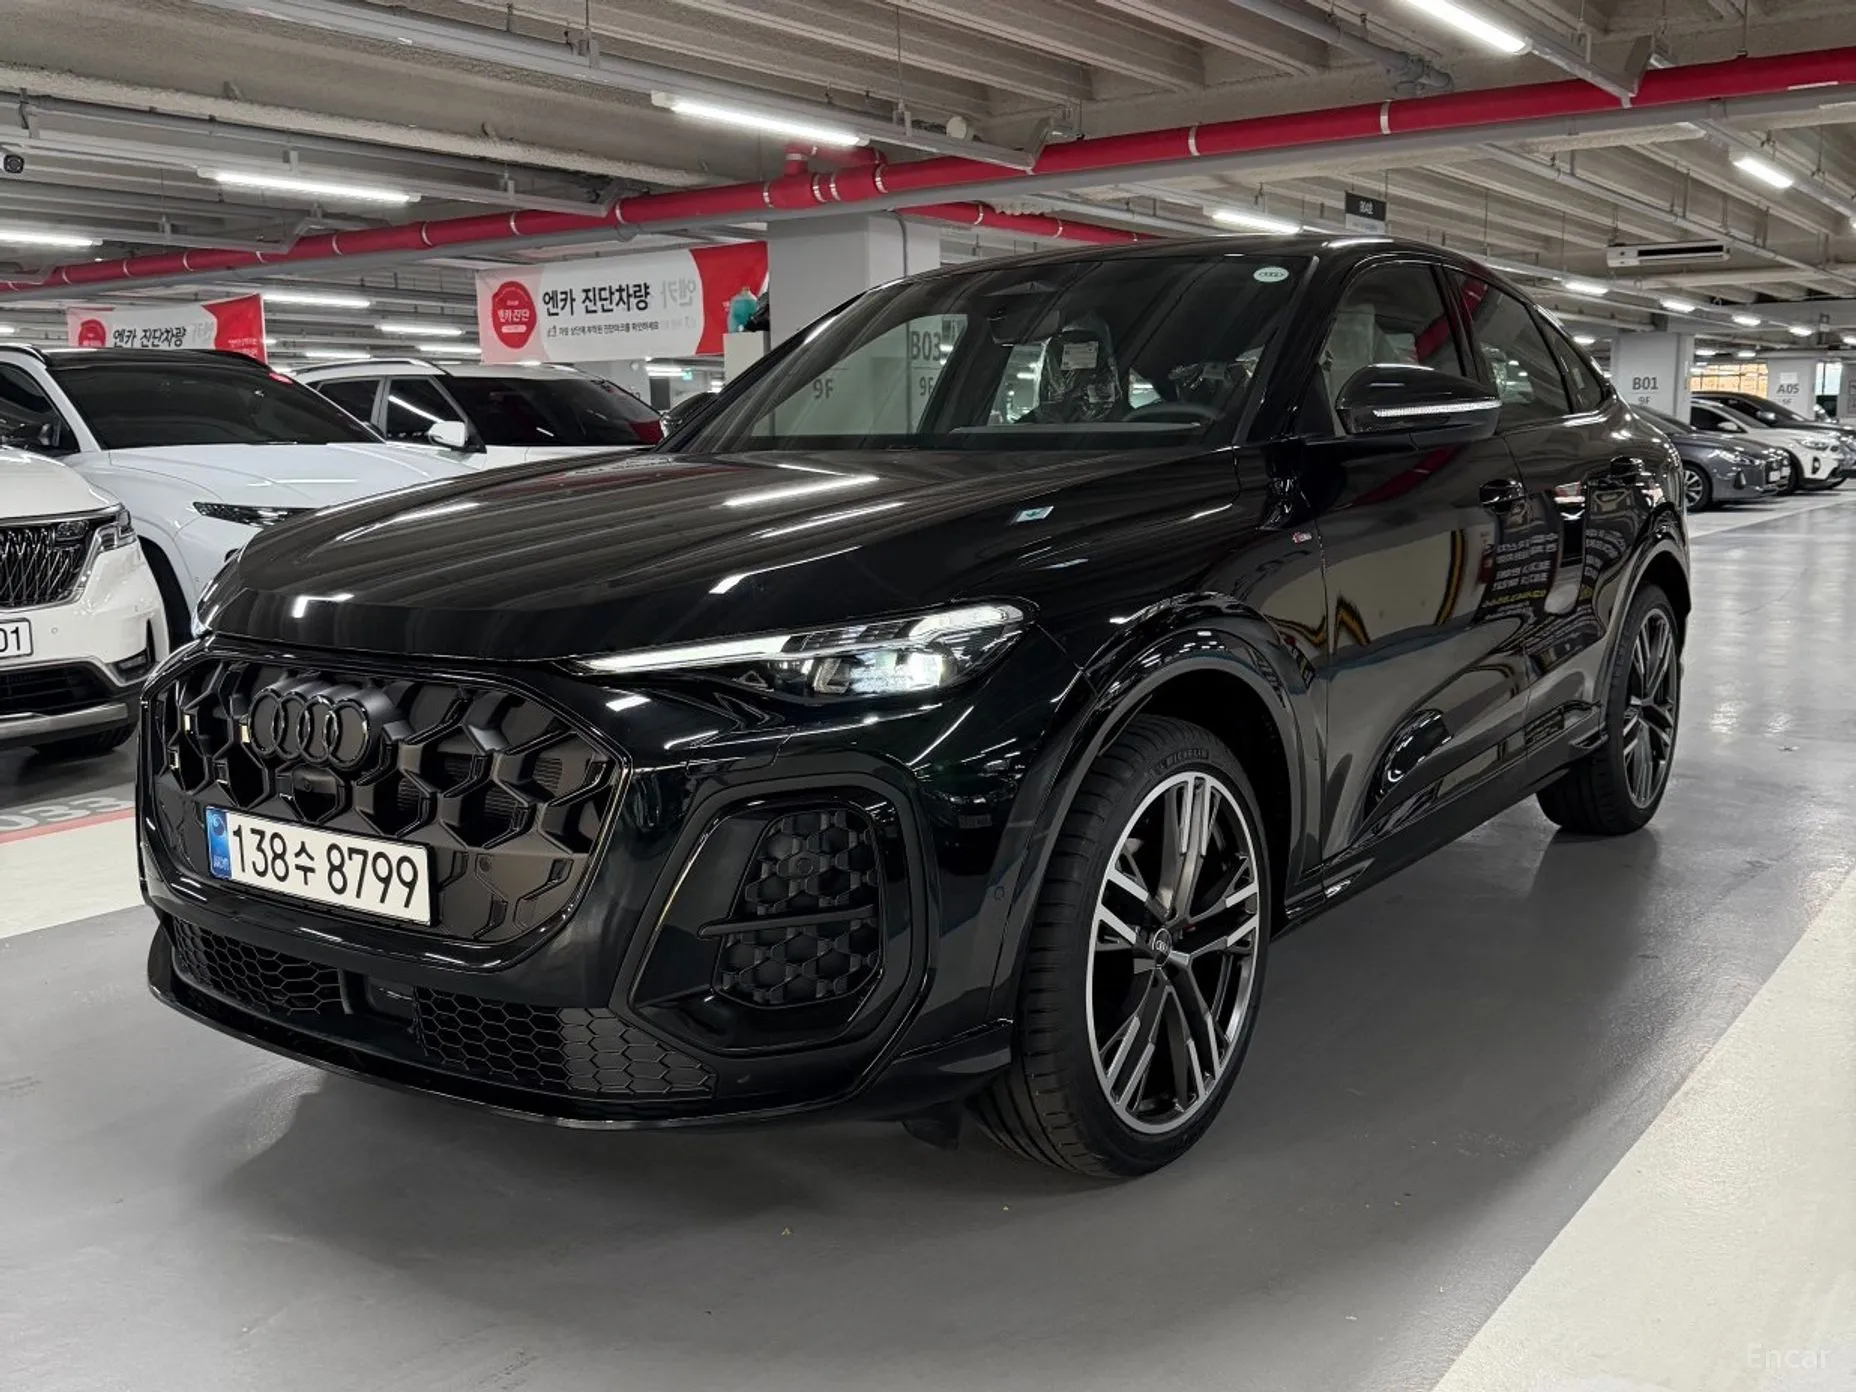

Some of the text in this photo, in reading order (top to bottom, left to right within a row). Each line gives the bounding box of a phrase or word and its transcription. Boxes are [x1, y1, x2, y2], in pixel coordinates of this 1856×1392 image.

[542, 289, 576, 316] 엔카
[582, 282, 651, 314] 진단차량
[113, 329, 136, 347] 엔카
[140, 326, 187, 348] 진단차량
[911, 330, 941, 361] B03
[813, 379, 834, 399] 9F
[1632, 377, 1658, 390] B01
[1776, 383, 1799, 394] A05
[232, 824, 418, 909] 138수 8799
